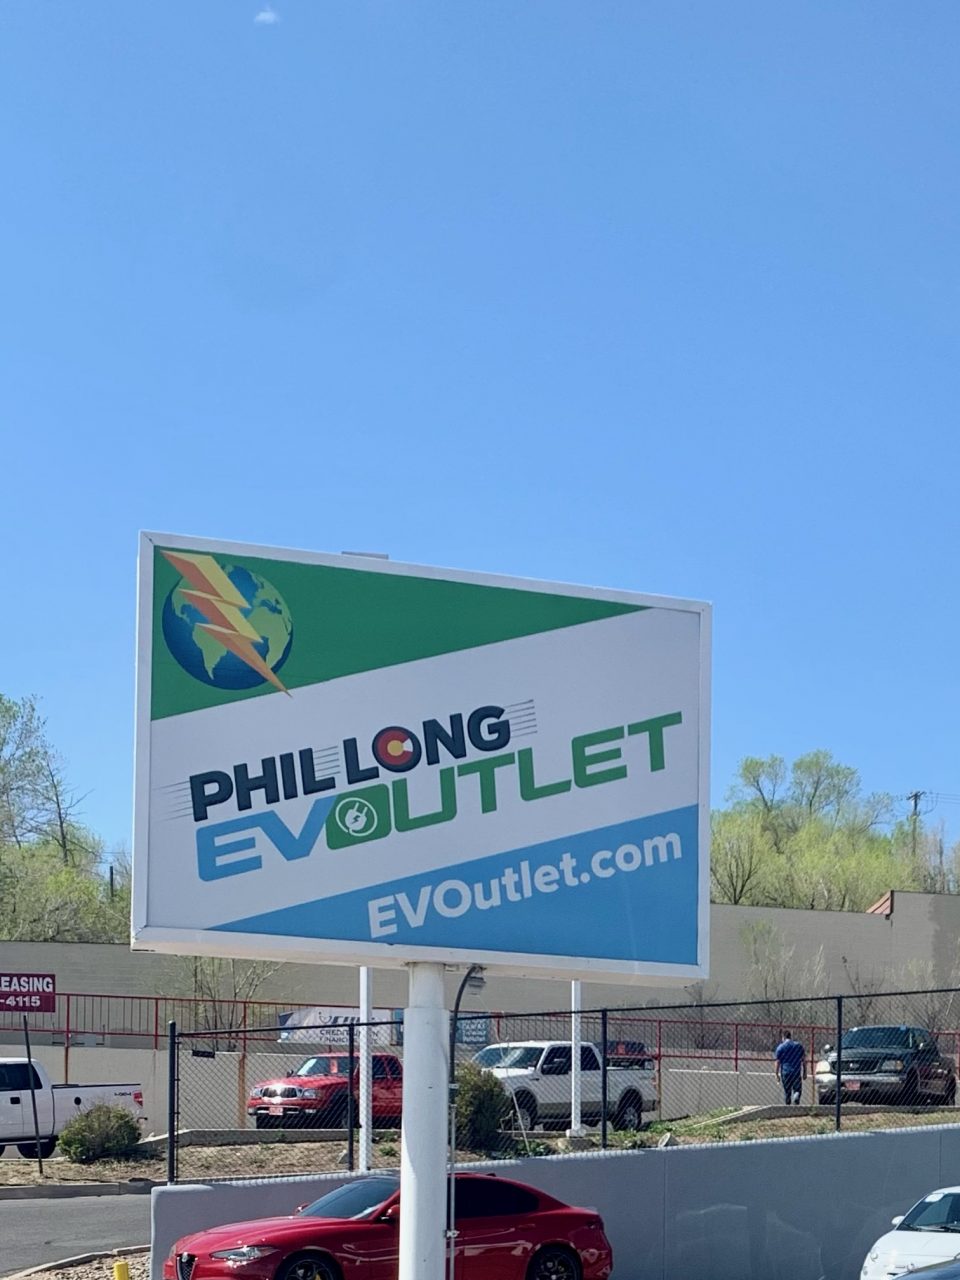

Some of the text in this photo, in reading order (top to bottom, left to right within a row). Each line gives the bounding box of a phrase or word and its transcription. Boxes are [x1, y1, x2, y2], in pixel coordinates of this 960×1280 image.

[188, 704, 512, 822] PHIL LONG
[367, 830, 683, 938] EVOutlet.com
[0, 977, 53, 992] EASING
